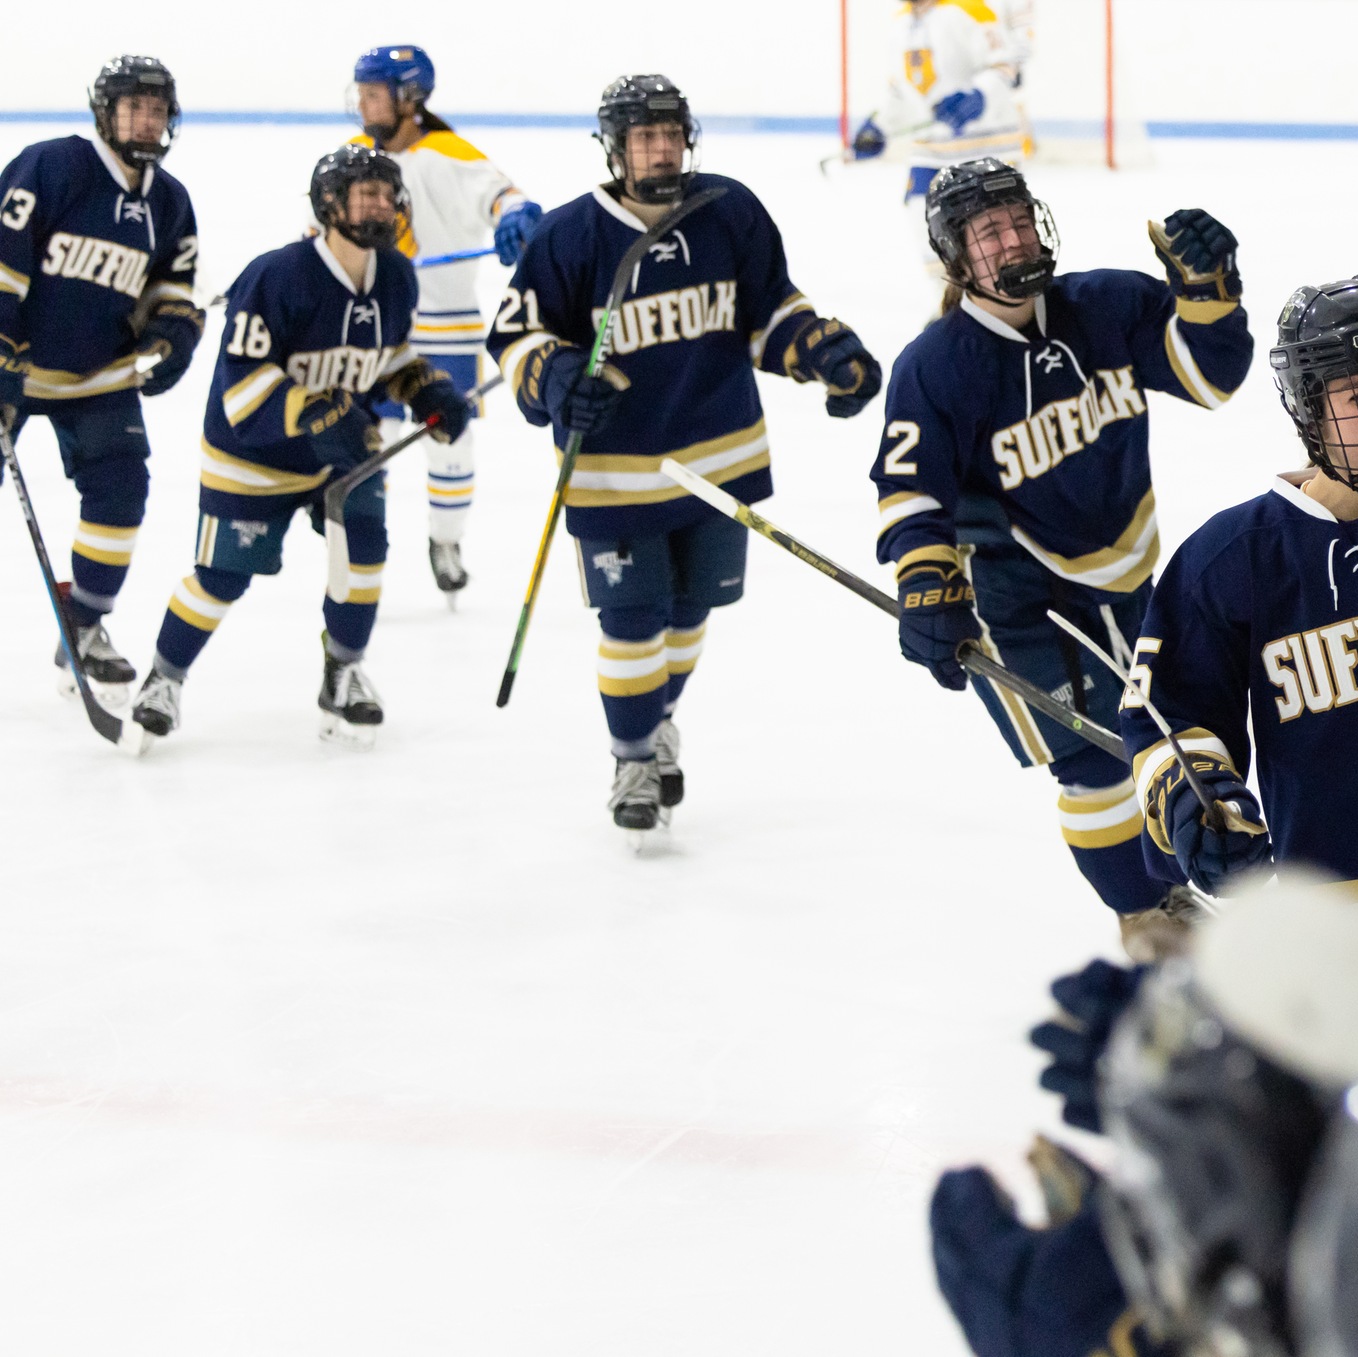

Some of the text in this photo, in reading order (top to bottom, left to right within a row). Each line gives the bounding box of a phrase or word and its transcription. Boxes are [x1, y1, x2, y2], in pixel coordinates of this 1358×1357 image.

[227, 311, 271, 359] 18
[495, 287, 544, 333] 21
[884, 420, 921, 475] 2
[991, 365, 1147, 491] SUFFOLK
[1119, 637, 1162, 713] 5
